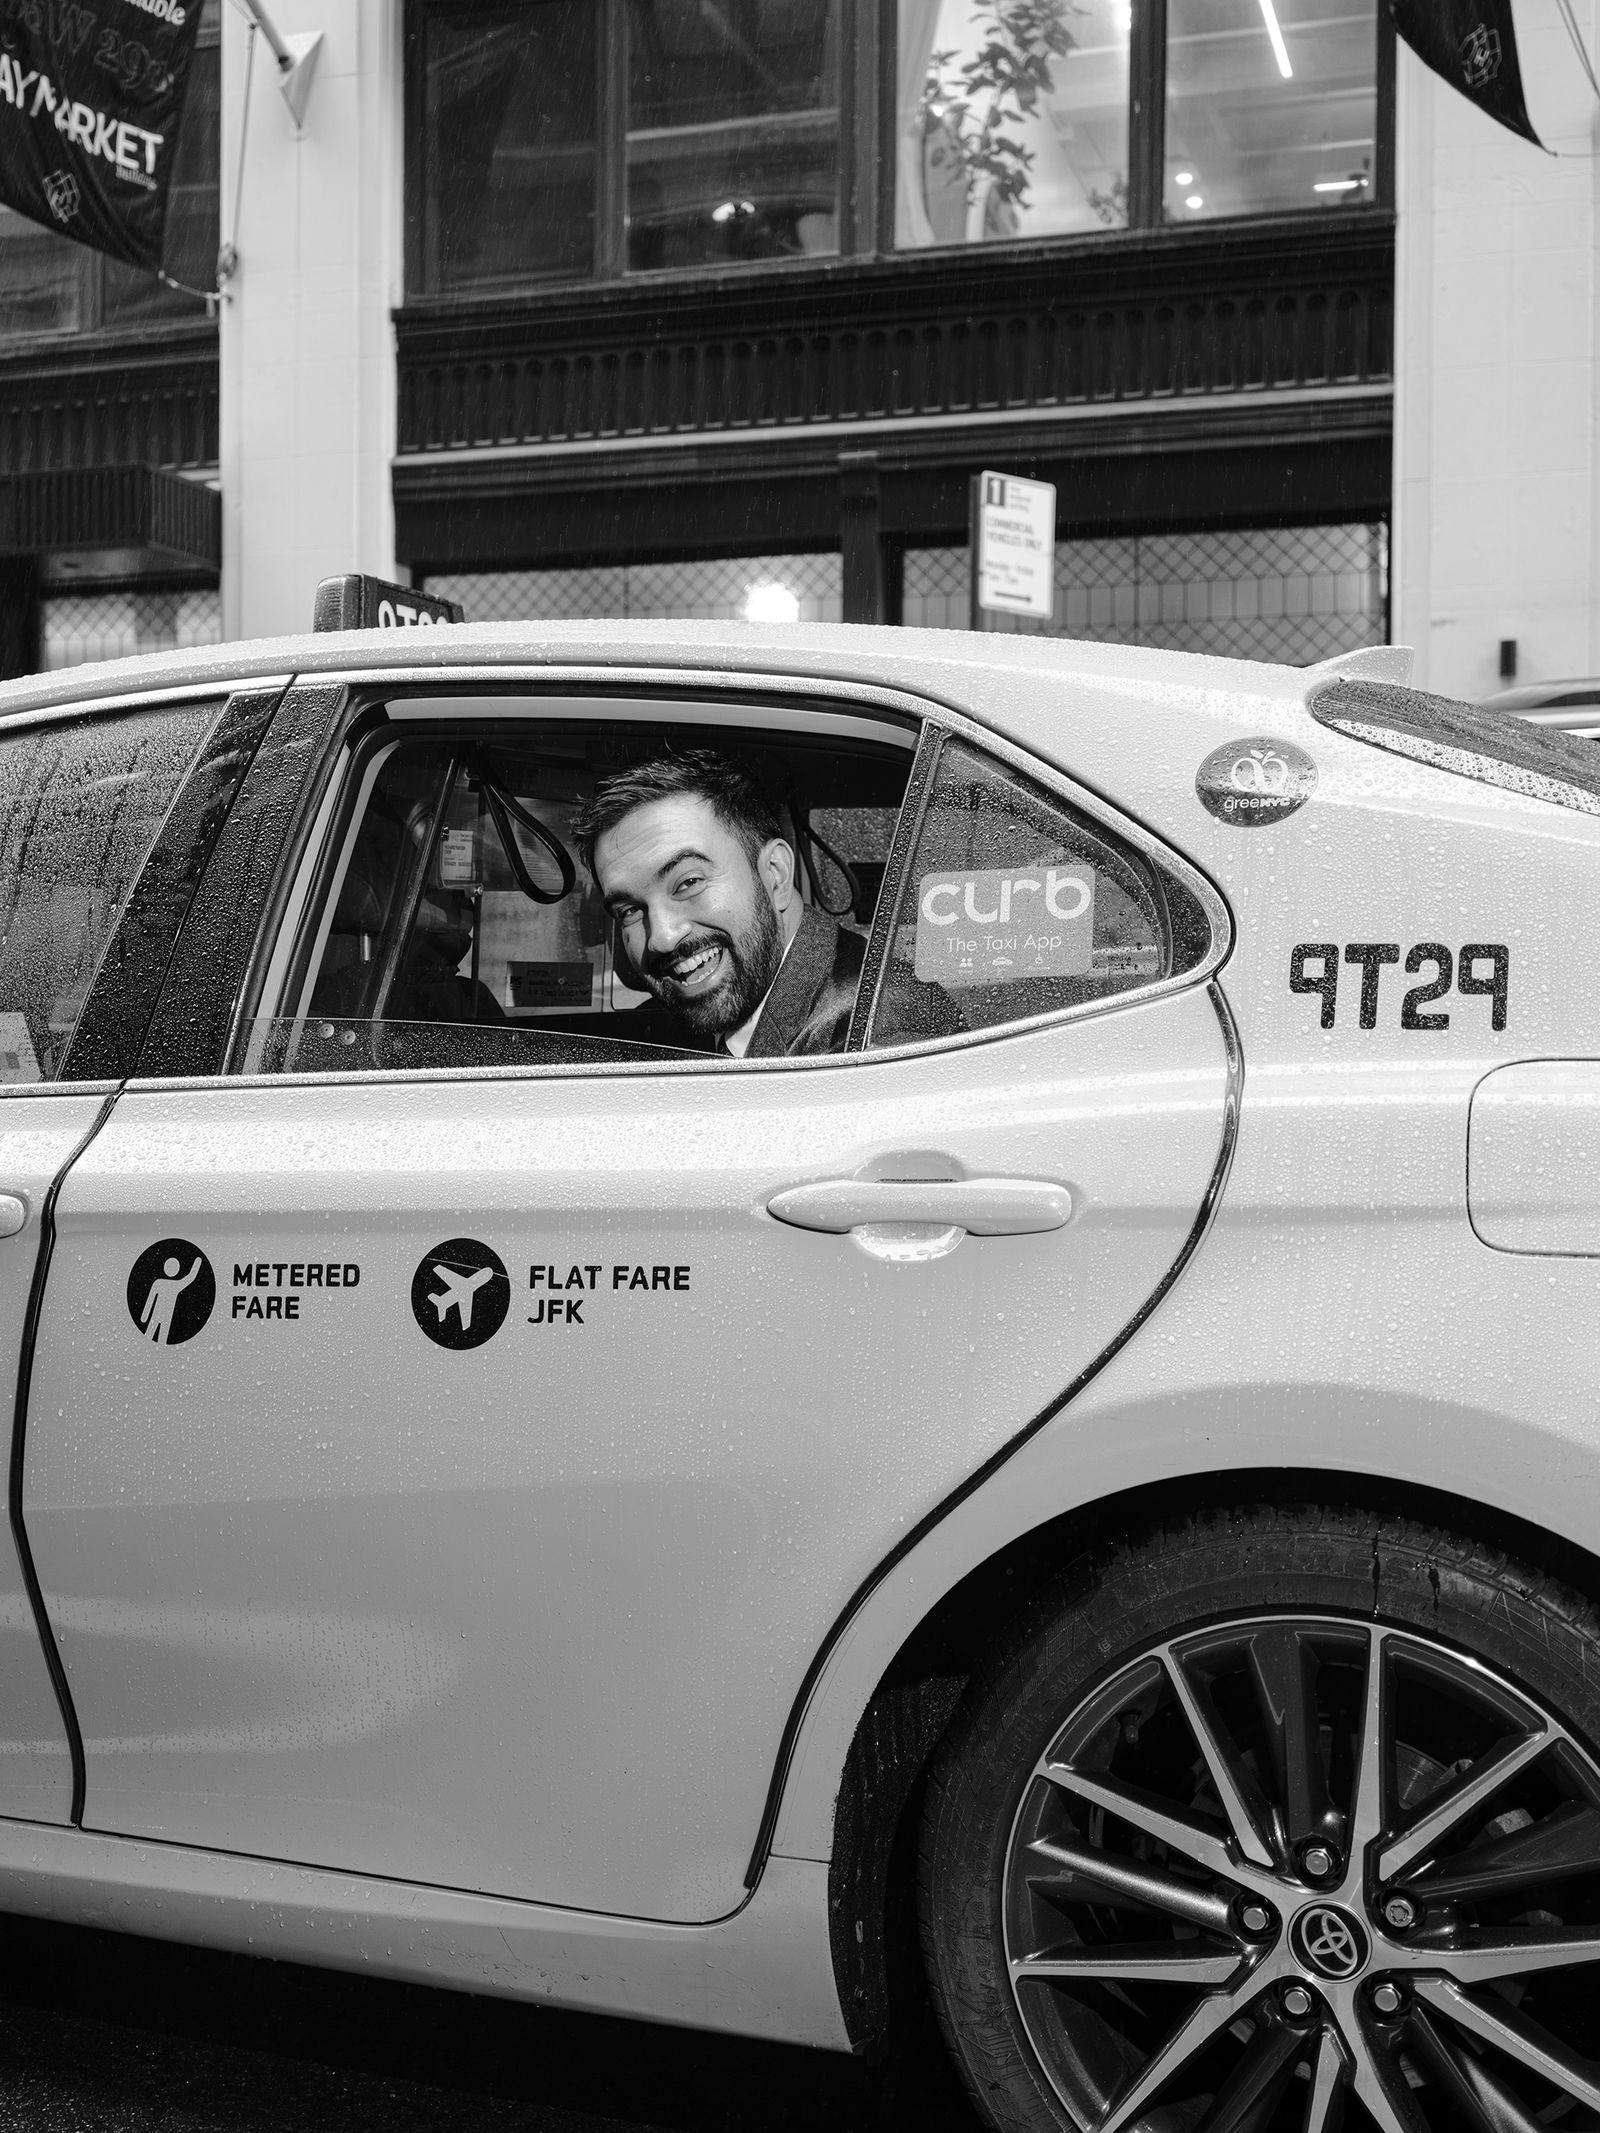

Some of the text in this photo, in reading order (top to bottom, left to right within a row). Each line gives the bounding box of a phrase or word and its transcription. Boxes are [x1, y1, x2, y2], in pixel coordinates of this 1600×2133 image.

[921, 870, 1092, 926] curb
[946, 934, 1062, 953] The Taxi App
[1289, 942, 1509, 1032] 9T29
[233, 1263, 360, 1287] METERED
[529, 1265, 691, 1291] FLAT FARE
[231, 1295, 300, 1320] FARE
[527, 1300, 584, 1324] JFK
